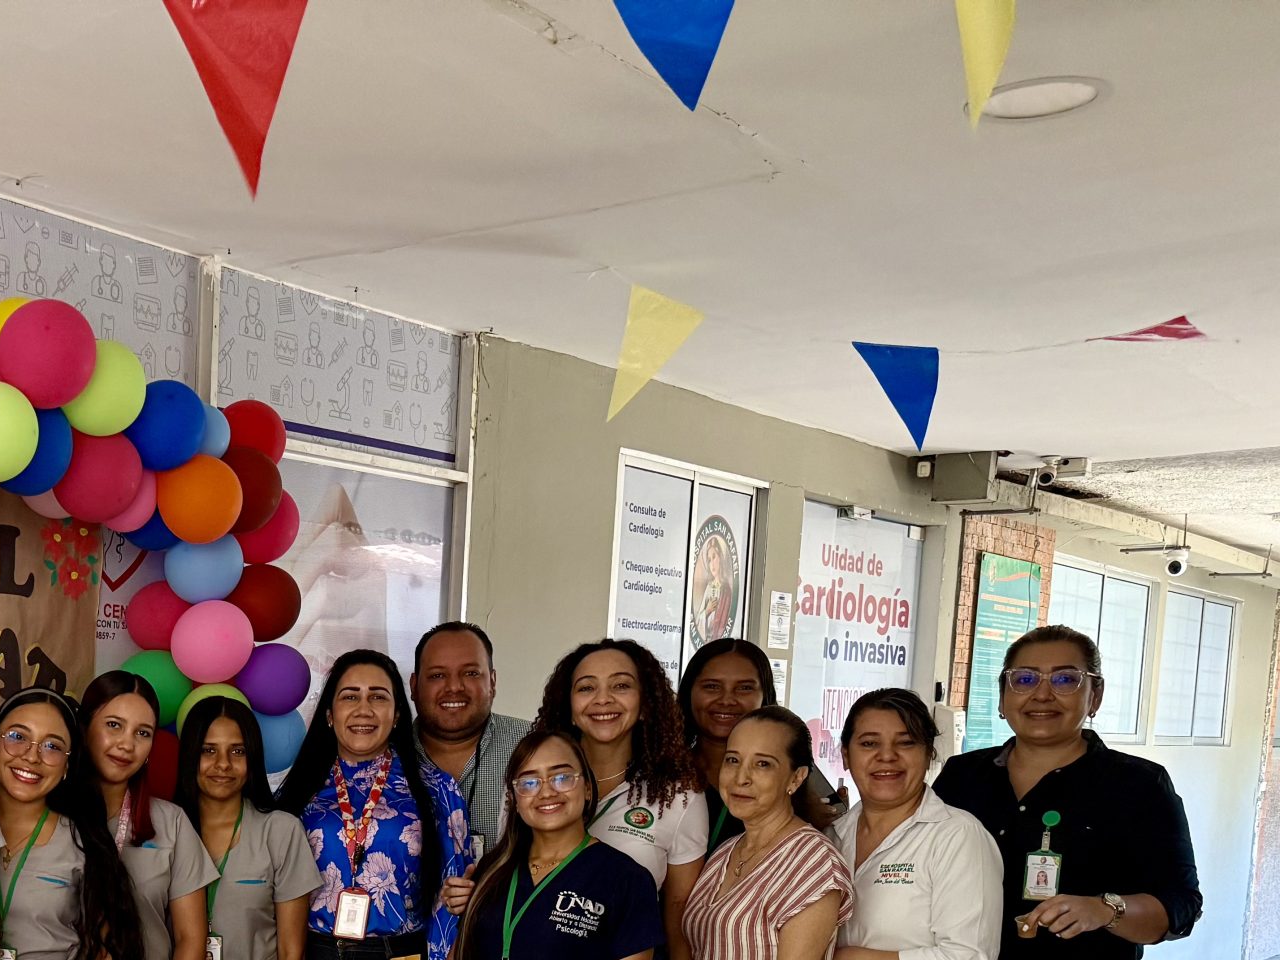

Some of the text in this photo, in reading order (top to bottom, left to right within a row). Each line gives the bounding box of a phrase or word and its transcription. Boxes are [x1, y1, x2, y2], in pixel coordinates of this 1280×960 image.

[629, 502, 666, 519] Consulta de
[713, 521, 727, 536] SAN
[726, 532, 739, 578] RAFAEL
[625, 560, 683, 580] Chequeo ejecutivo
[867, 553, 883, 576] de
[621, 618, 682, 635] Electrocardiograma
[844, 631, 906, 666] invasiva
[556, 894, 605, 915] UNAD
